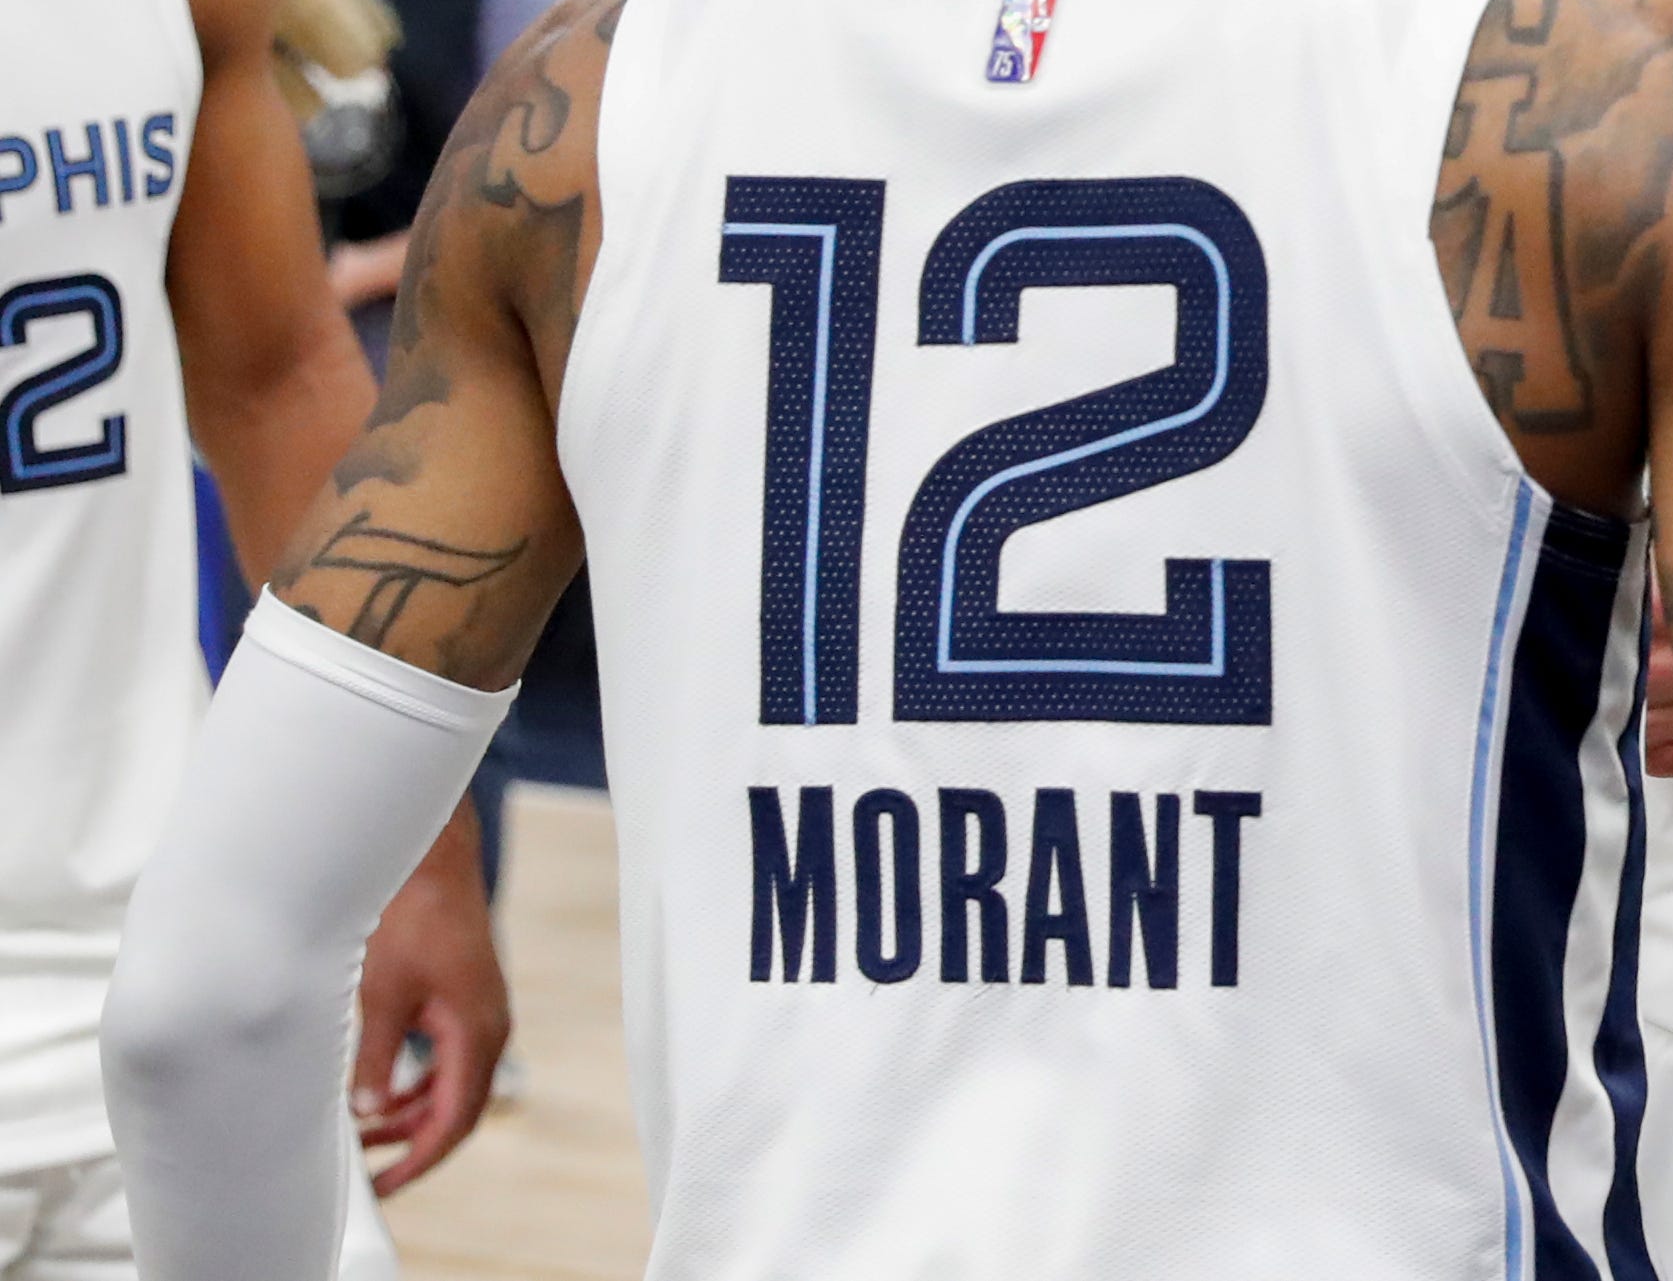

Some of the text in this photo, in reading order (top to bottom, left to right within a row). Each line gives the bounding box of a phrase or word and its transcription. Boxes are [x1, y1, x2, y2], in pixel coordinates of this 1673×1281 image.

[0, 274, 126, 493] 2
[719, 175, 1272, 726] 12
[747, 785, 1262, 990] MORANT
